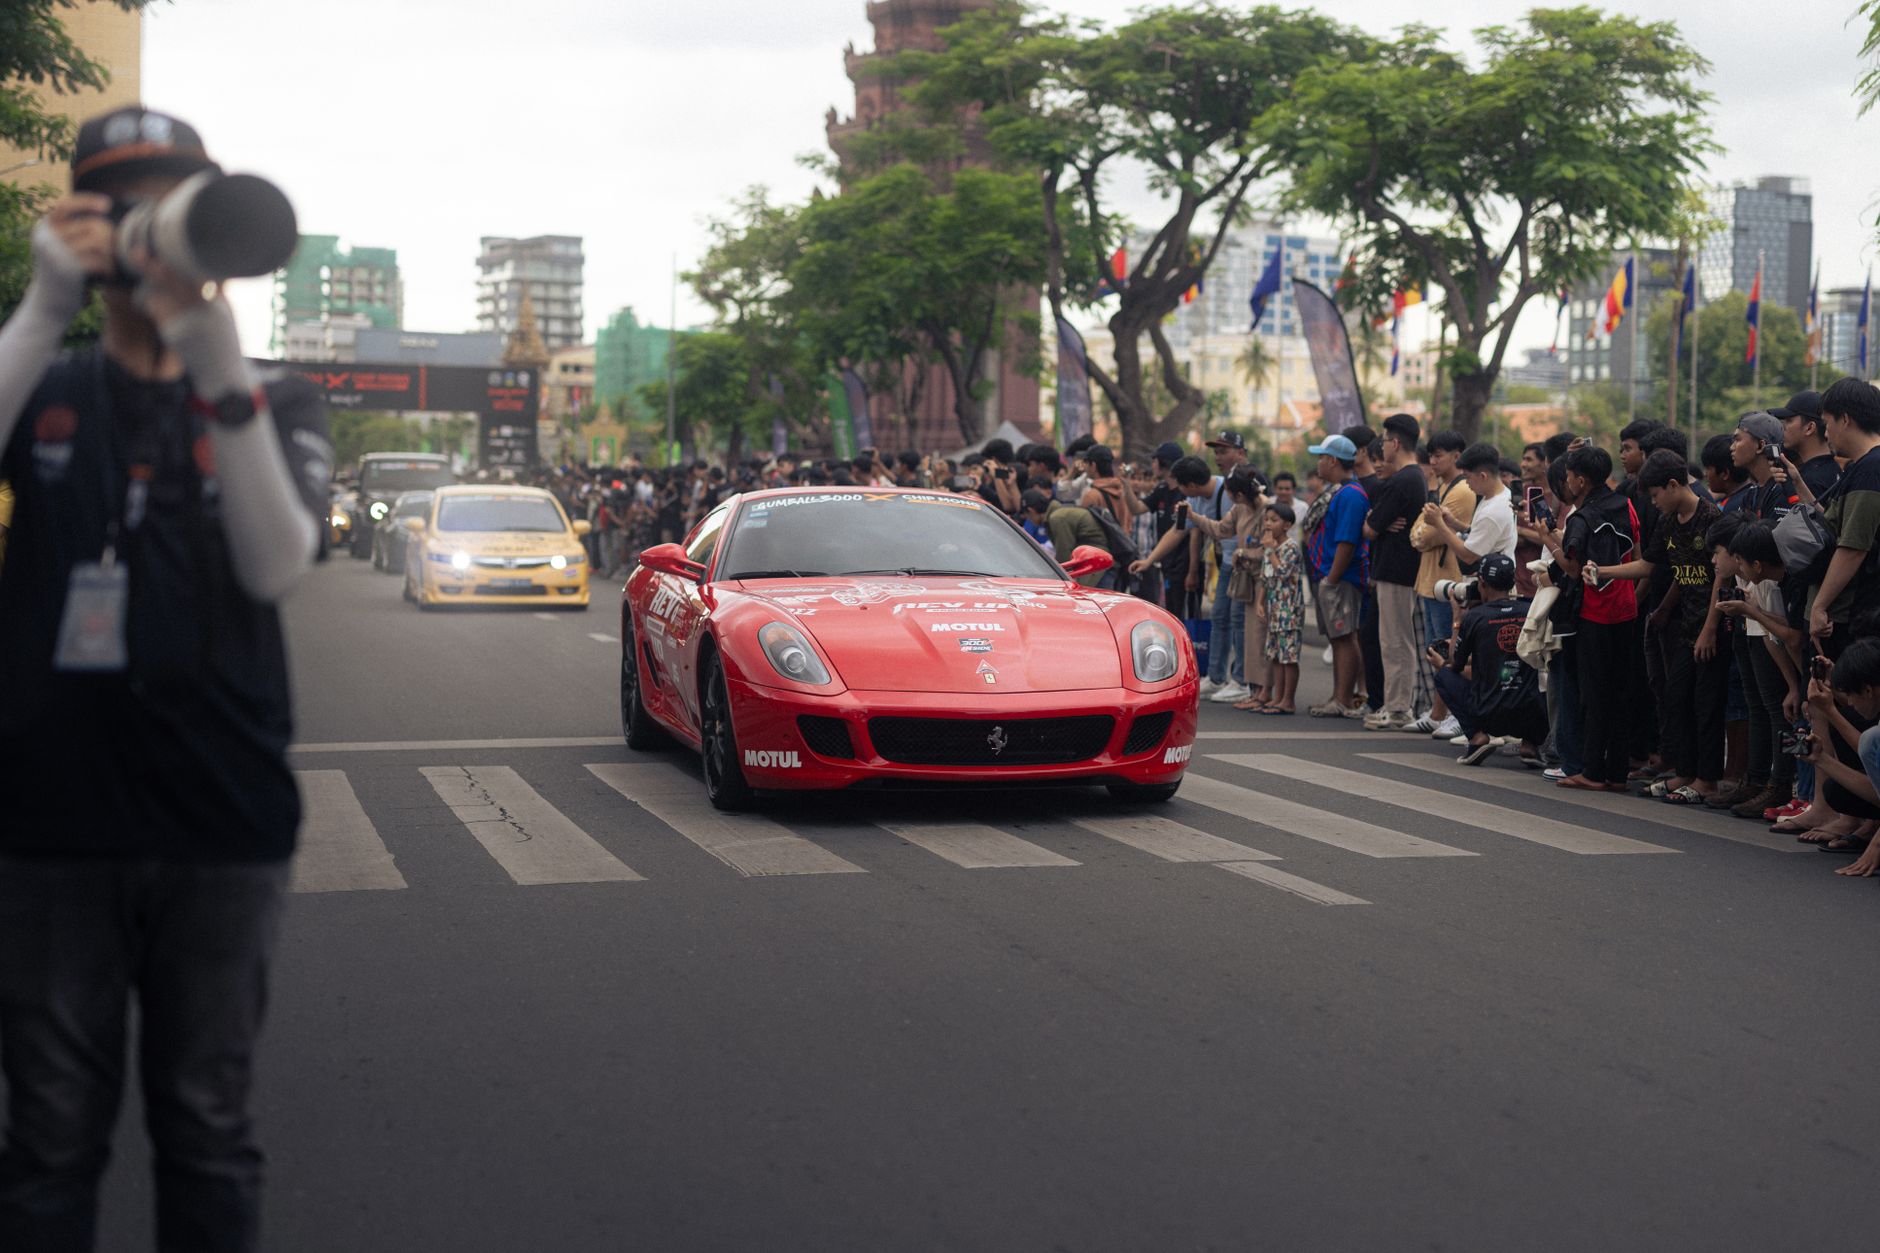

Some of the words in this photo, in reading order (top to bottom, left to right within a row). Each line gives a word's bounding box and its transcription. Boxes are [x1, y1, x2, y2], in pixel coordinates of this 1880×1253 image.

[1671, 565, 1708, 580] QATAR
[931, 623, 1005, 632] MOTUL
[745, 749, 802, 768] MOTUL
[1163, 744, 1192, 764] MOTU
